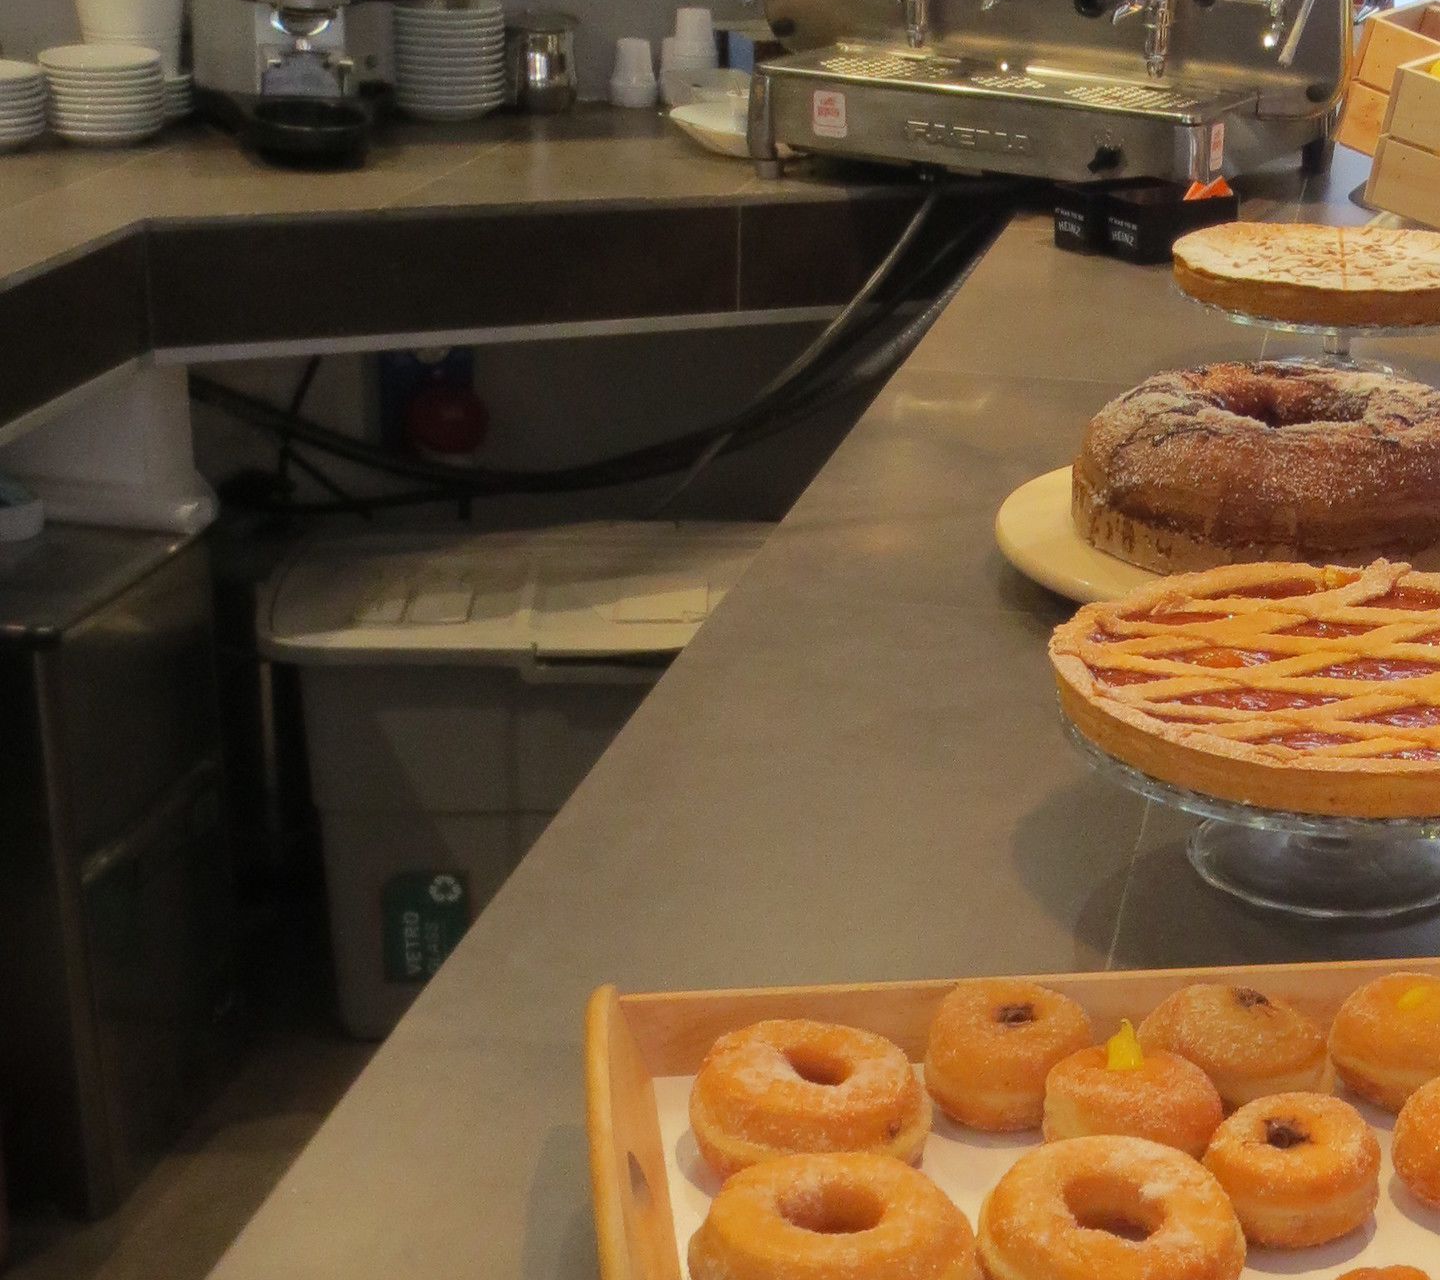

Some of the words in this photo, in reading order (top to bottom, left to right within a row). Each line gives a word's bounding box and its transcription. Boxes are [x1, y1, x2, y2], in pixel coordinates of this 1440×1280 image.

[1058, 220, 1081, 237] HEINZ
[1111, 230, 1135, 246] HEINZ
[403, 911, 422, 975] VETRO
